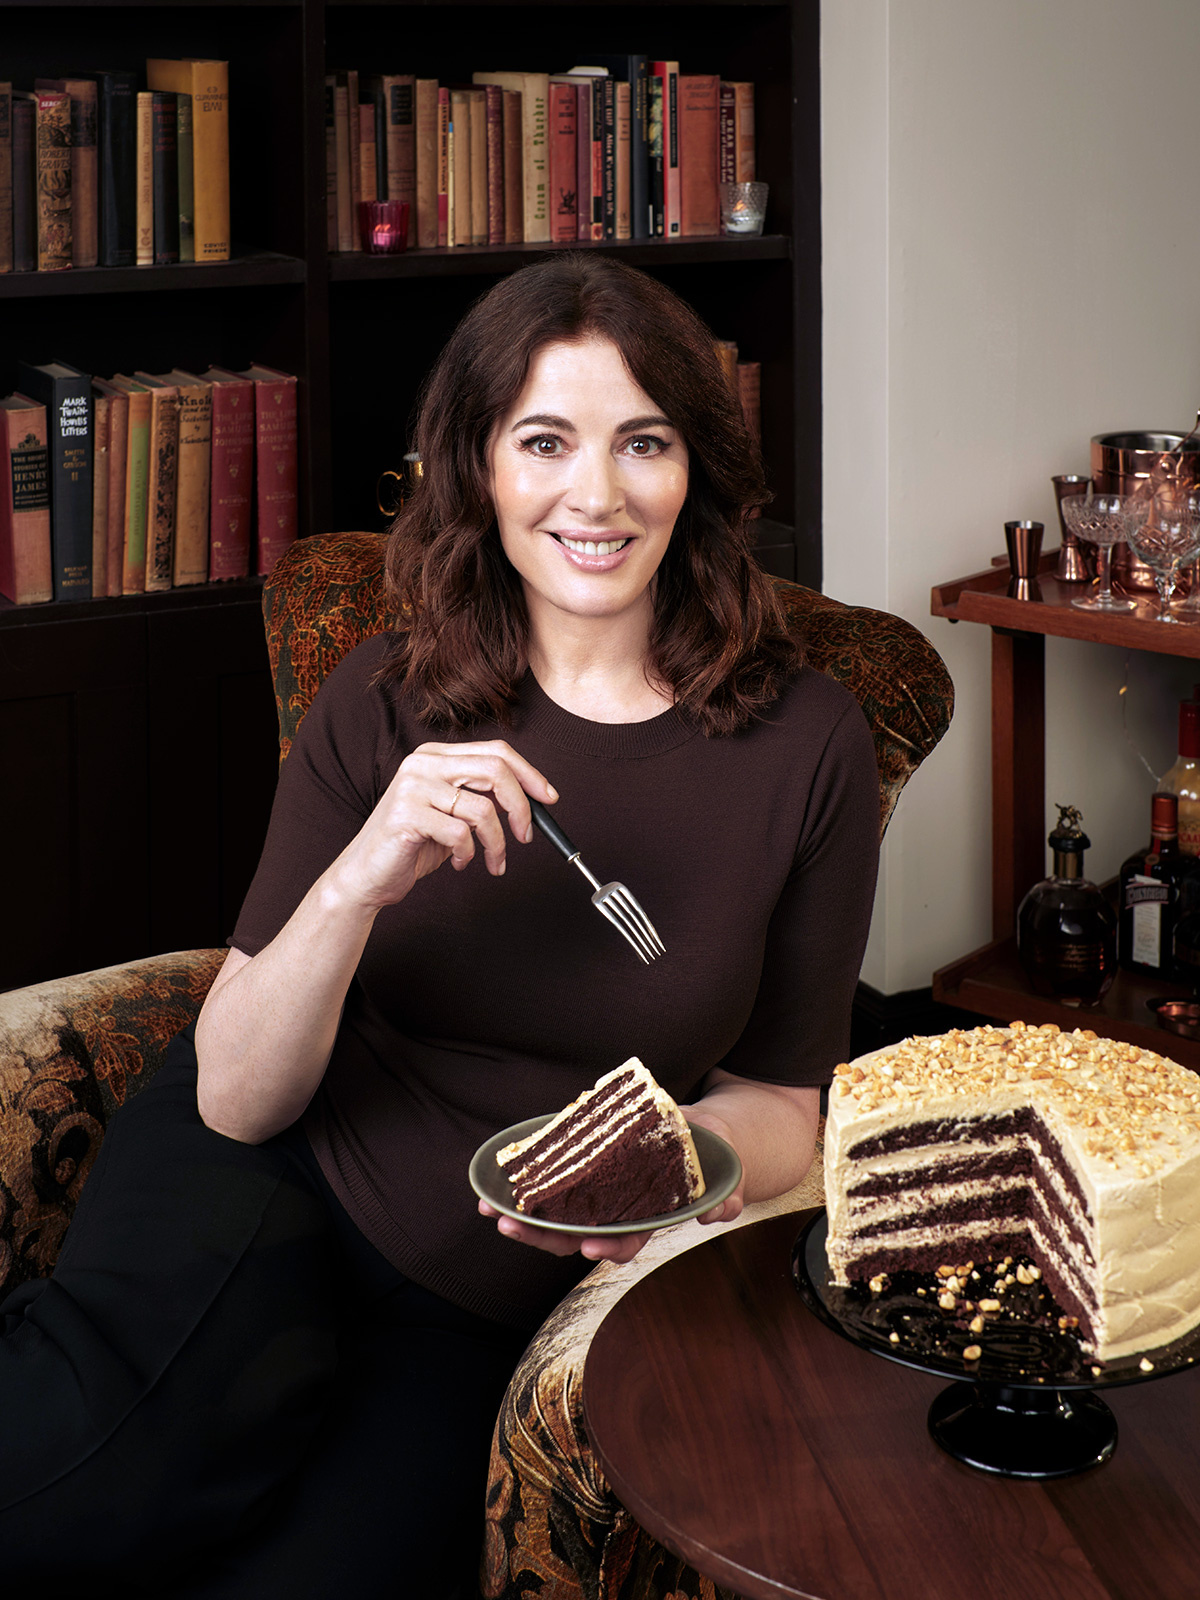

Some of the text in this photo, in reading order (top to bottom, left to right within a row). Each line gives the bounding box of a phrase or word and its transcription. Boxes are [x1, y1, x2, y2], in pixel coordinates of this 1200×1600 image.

[532, 97, 547, 146] Thurber
[726, 119, 735, 149] DEAR
[606, 133, 614, 155] Alice
[40, 149, 70, 158] ROBERT
[40, 159, 71, 169] GRAVES
[605, 170, 614, 191] guide
[533, 183, 547, 219] Cream
[606, 193, 614, 201] to
[62, 396, 87, 406] MARK
[215, 413, 232, 422] THE
[261, 411, 277, 419] THE
[61, 426, 88, 437] LETTERS
[28, 454, 46, 462] SHORT
[14, 471, 47, 482] HENRY
[15, 482, 47, 493] JAMES
